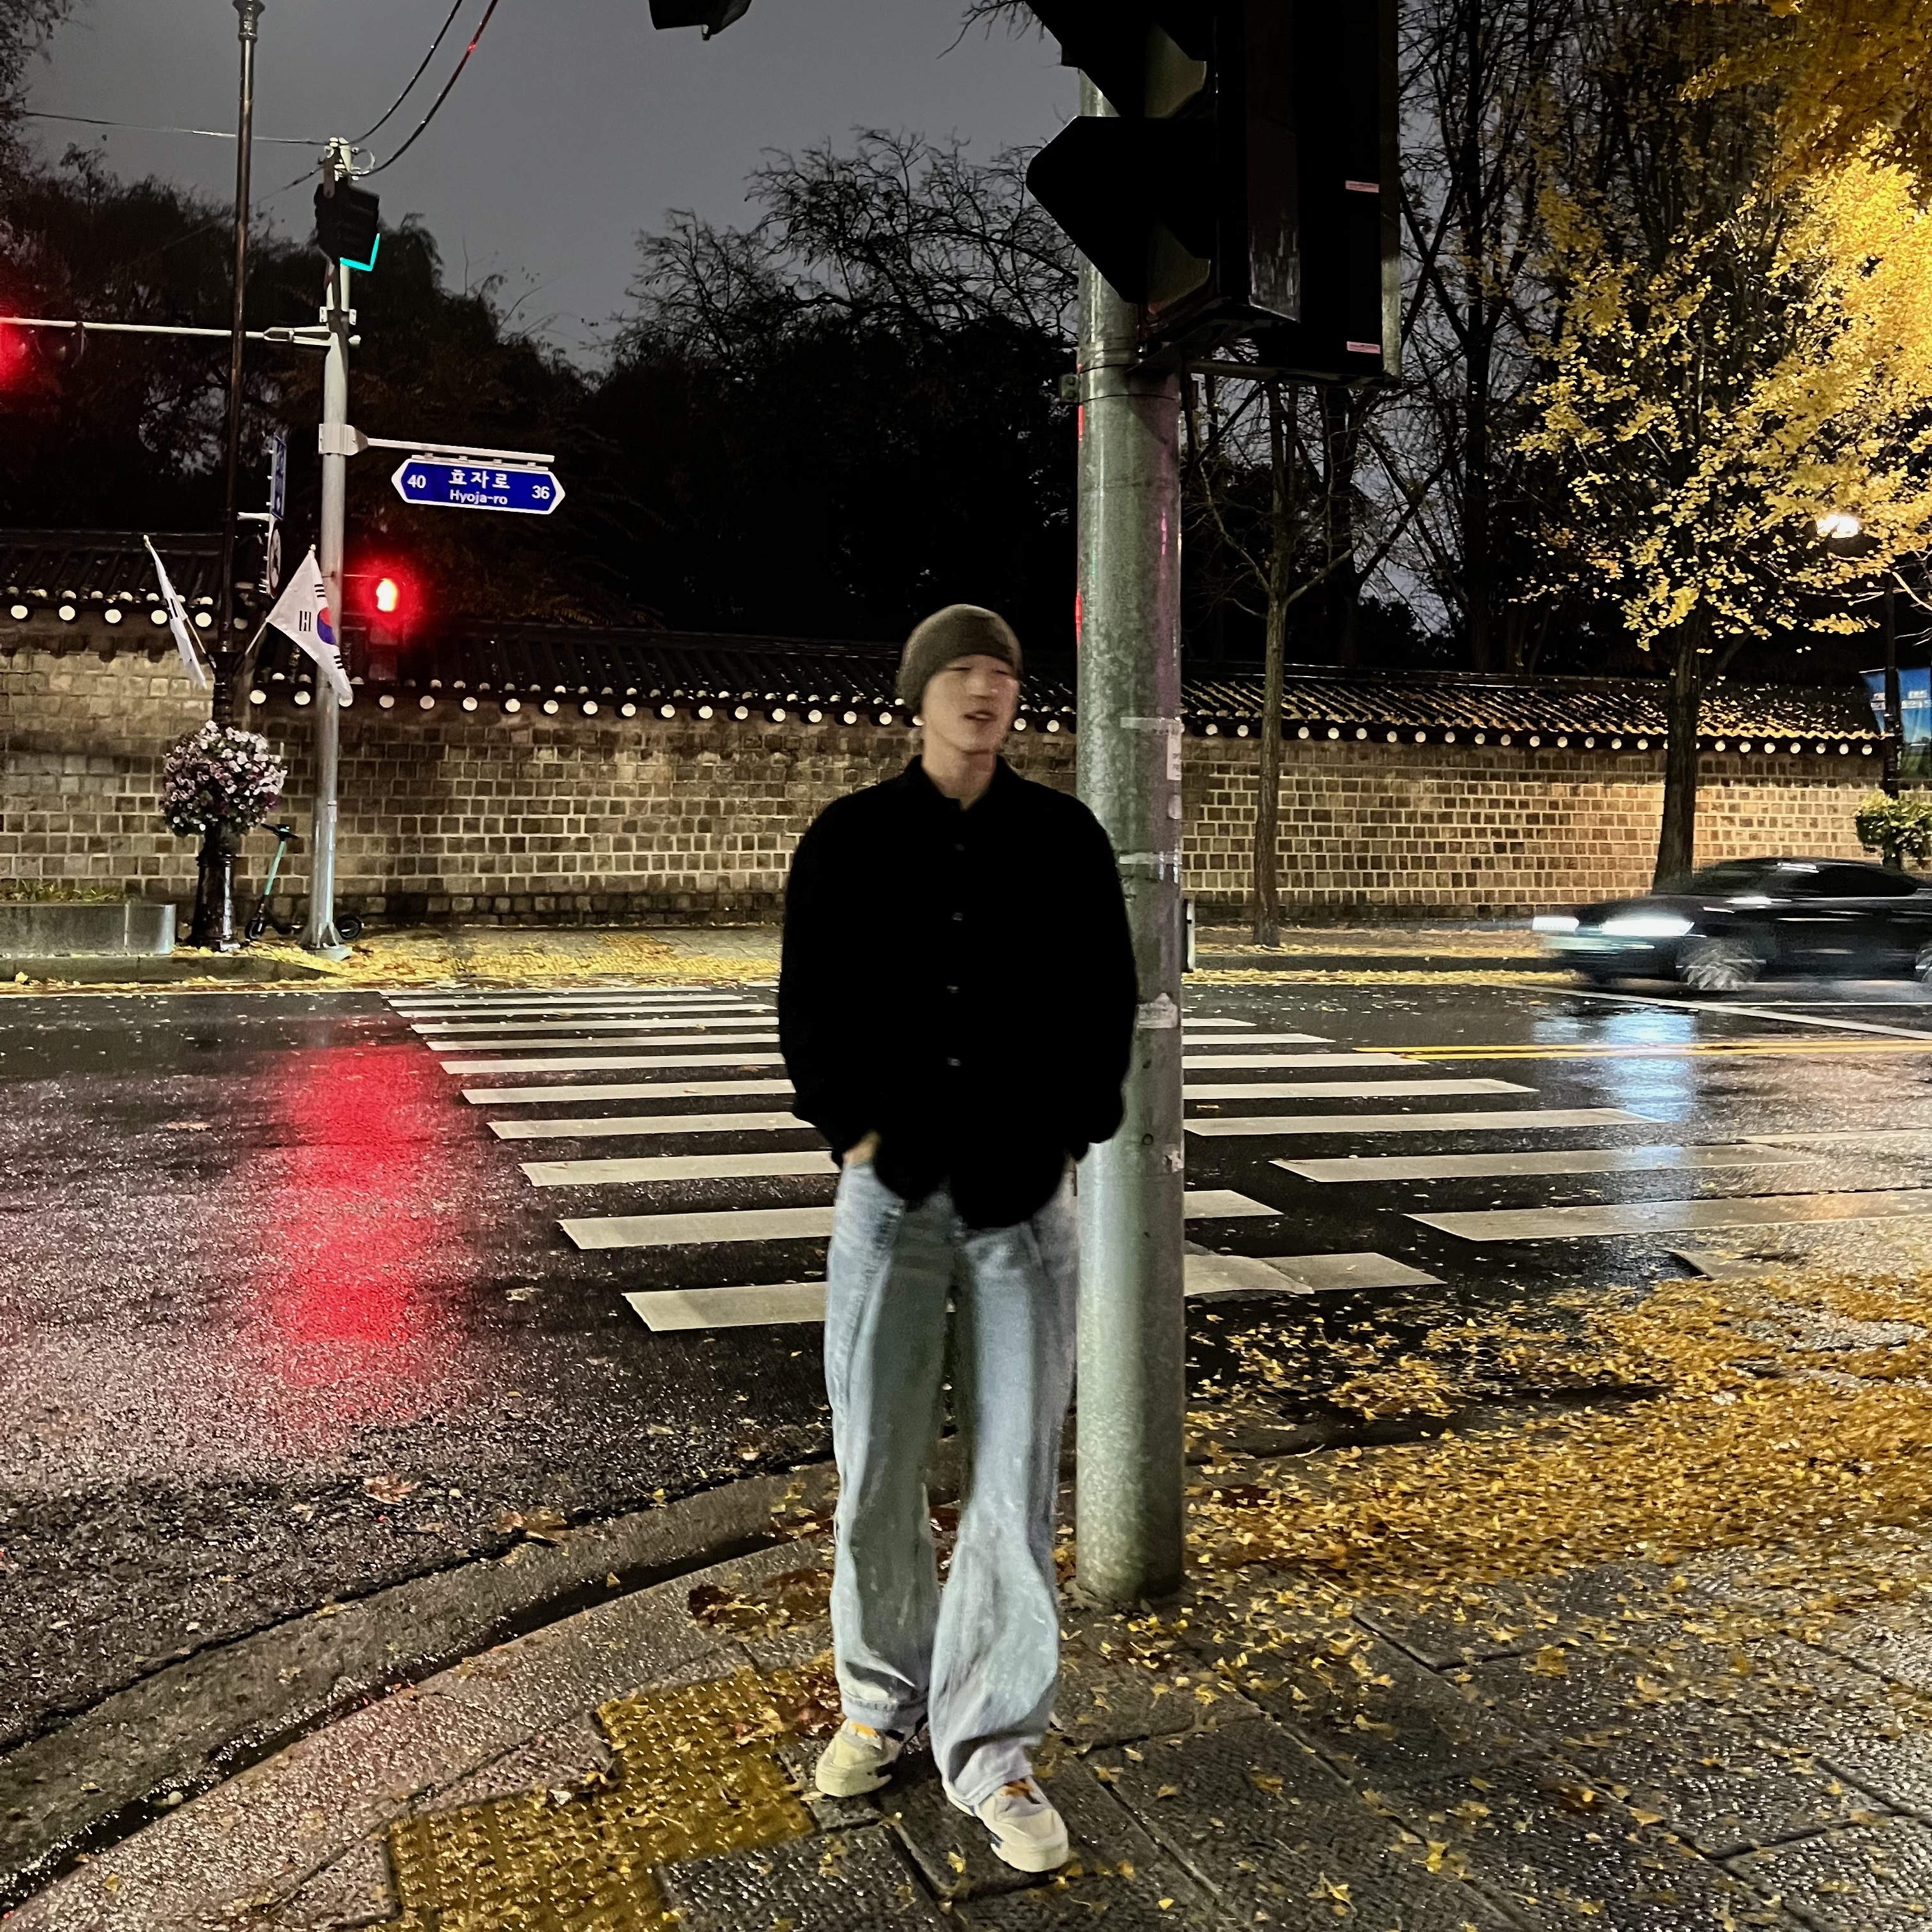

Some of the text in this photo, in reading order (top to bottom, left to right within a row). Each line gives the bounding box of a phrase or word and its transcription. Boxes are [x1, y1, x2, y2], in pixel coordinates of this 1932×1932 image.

[407, 474, 426, 489] 40
[448, 469, 510, 489] 효자로
[449, 489, 508, 505] Hyoja-ro
[531, 485, 550, 500] 36
